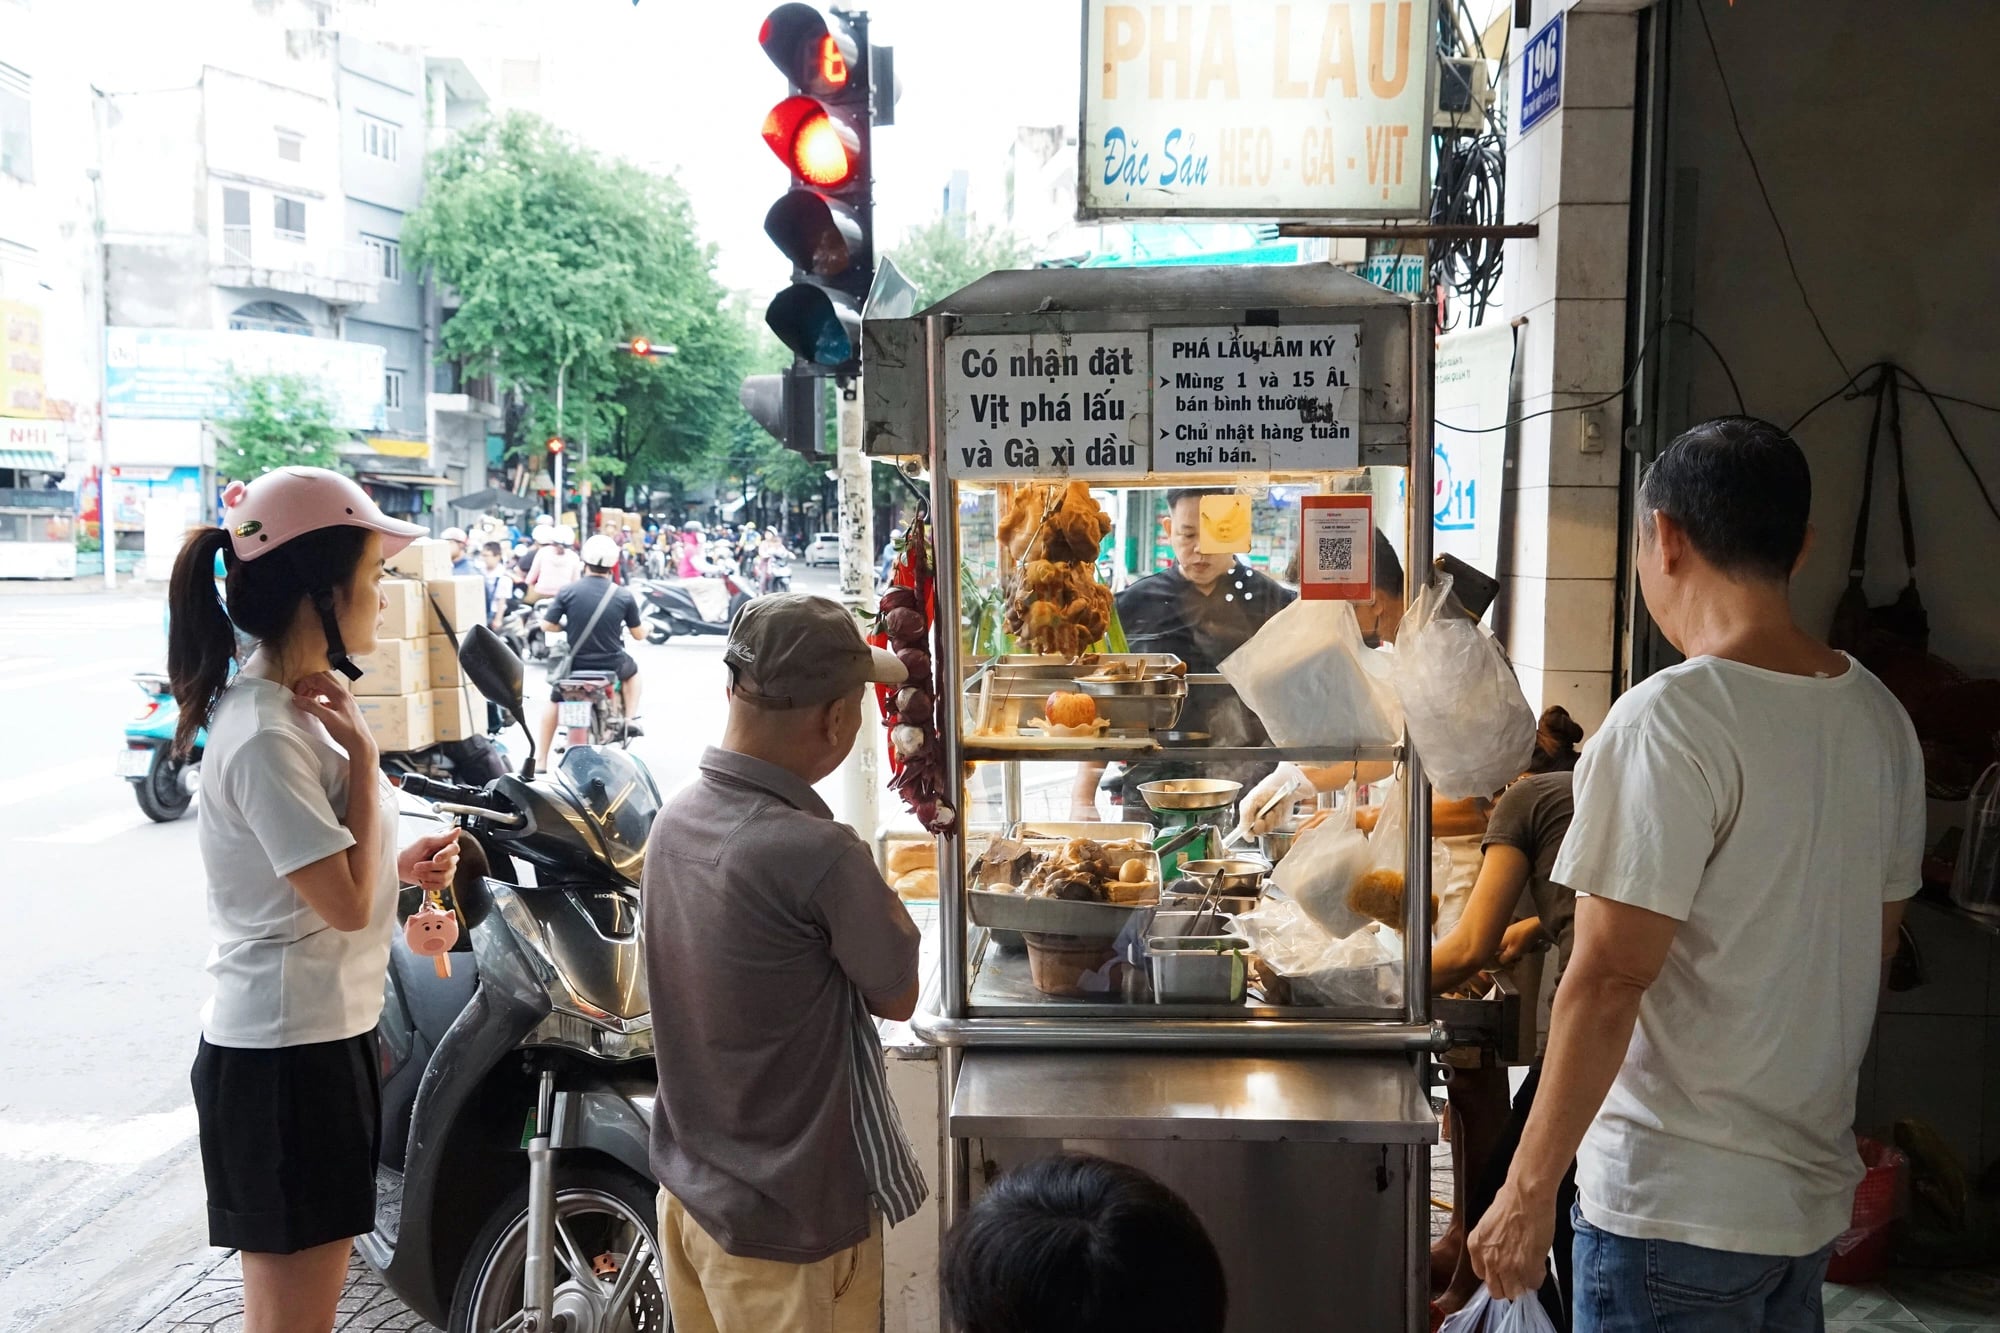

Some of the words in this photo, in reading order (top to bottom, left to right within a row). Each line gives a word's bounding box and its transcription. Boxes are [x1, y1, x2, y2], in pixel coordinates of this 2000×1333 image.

[1525, 26, 1557, 97] 196
[1103, 126, 1150, 202] Đặc
[1158, 126, 1209, 188] Sản
[1218, 126, 1274, 188] HEO
[1300, 110, 1336, 186] GÀ
[1365, 123, 1409, 200] VỊT
[1172, 337, 1210, 358] PHÁ
[1217, 334, 1254, 358] LẤU
[1261, 336, 1303, 357] LÂM
[1310, 335, 1336, 357] KÝ
[962, 348, 998, 378] Có
[1010, 348, 1078, 384] nhận
[1089, 347, 1133, 384] đặt
[1176, 372, 1224, 391] Mùng
[1237, 372, 1247, 388] 1
[1259, 371, 1278, 388] và
[1293, 371, 1315, 388] 15
[1326, 366, 1350, 387] ÂL
[970, 394, 1009, 429] Vịt
[1021, 393, 1071, 428] phá
[1083, 389, 1125, 421] lấu
[1176, 395, 1208, 411] bán
[1214, 395, 1251, 411] bình
[1175, 423, 1208, 440] Chủ
[1215, 423, 1254, 443] nhật
[1261, 423, 1304, 443] hàng
[1311, 420, 1350, 440] tuần
[961, 439, 992, 467] và
[1004, 438, 1039, 467] Gà
[1051, 438, 1075, 467] xì
[1085, 432, 1135, 466] dầu
[1175, 446, 1213, 466] nghỉ
[1219, 447, 1257, 463] bán.
